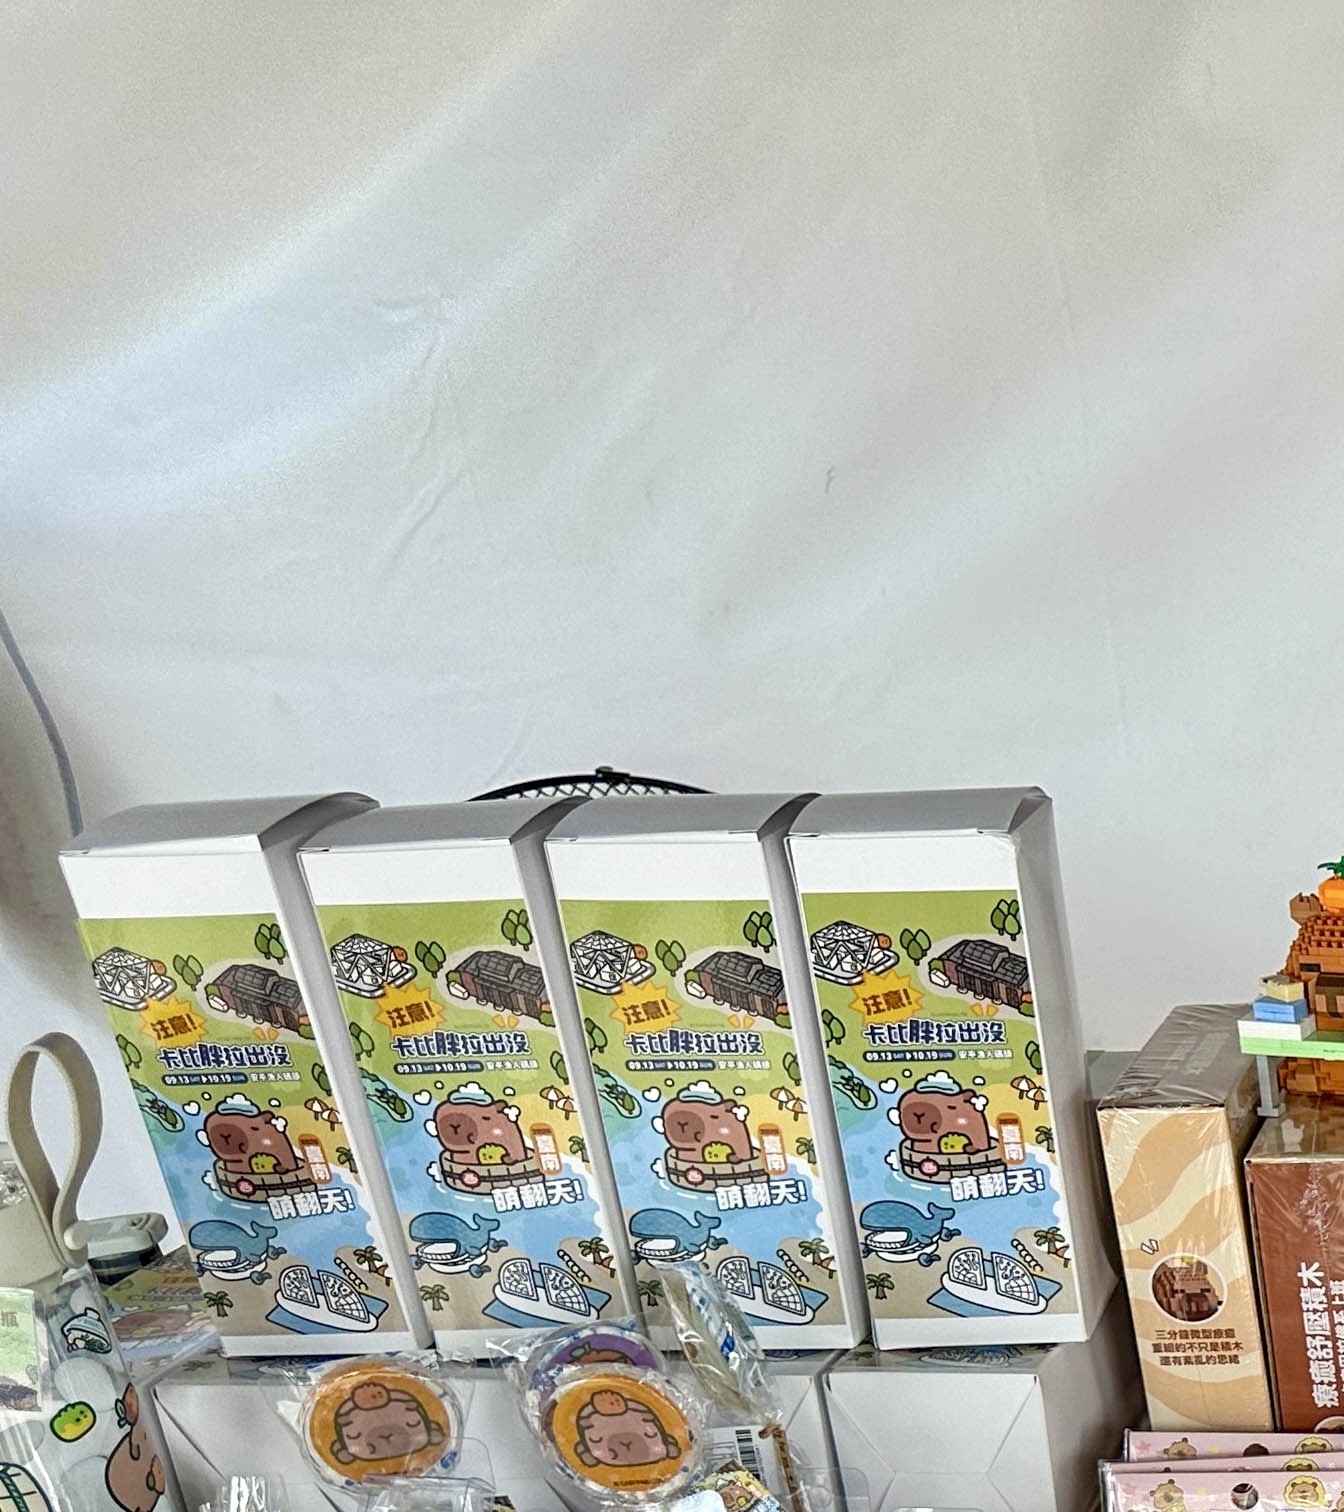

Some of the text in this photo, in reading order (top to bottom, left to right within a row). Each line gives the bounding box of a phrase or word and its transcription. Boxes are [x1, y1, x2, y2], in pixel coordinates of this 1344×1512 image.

[390, 1031, 531, 1058] 卡比胖拉出沒
[624, 1027, 763, 1055] 卡比胖拉出沒
[863, 1018, 1006, 1045] 卡比胖拉出沒
[158, 1043, 292, 1070] 卡比胖拉出沒
[491, 1179, 584, 1213] 萌翻天!
[715, 1179, 808, 1211] 萌翻天!
[950, 1168, 1045, 1202] 萌翻天!
[267, 1188, 356, 1219] 萌翻天!
[1297, 1262, 1339, 1409] 療癒舒壓積木
